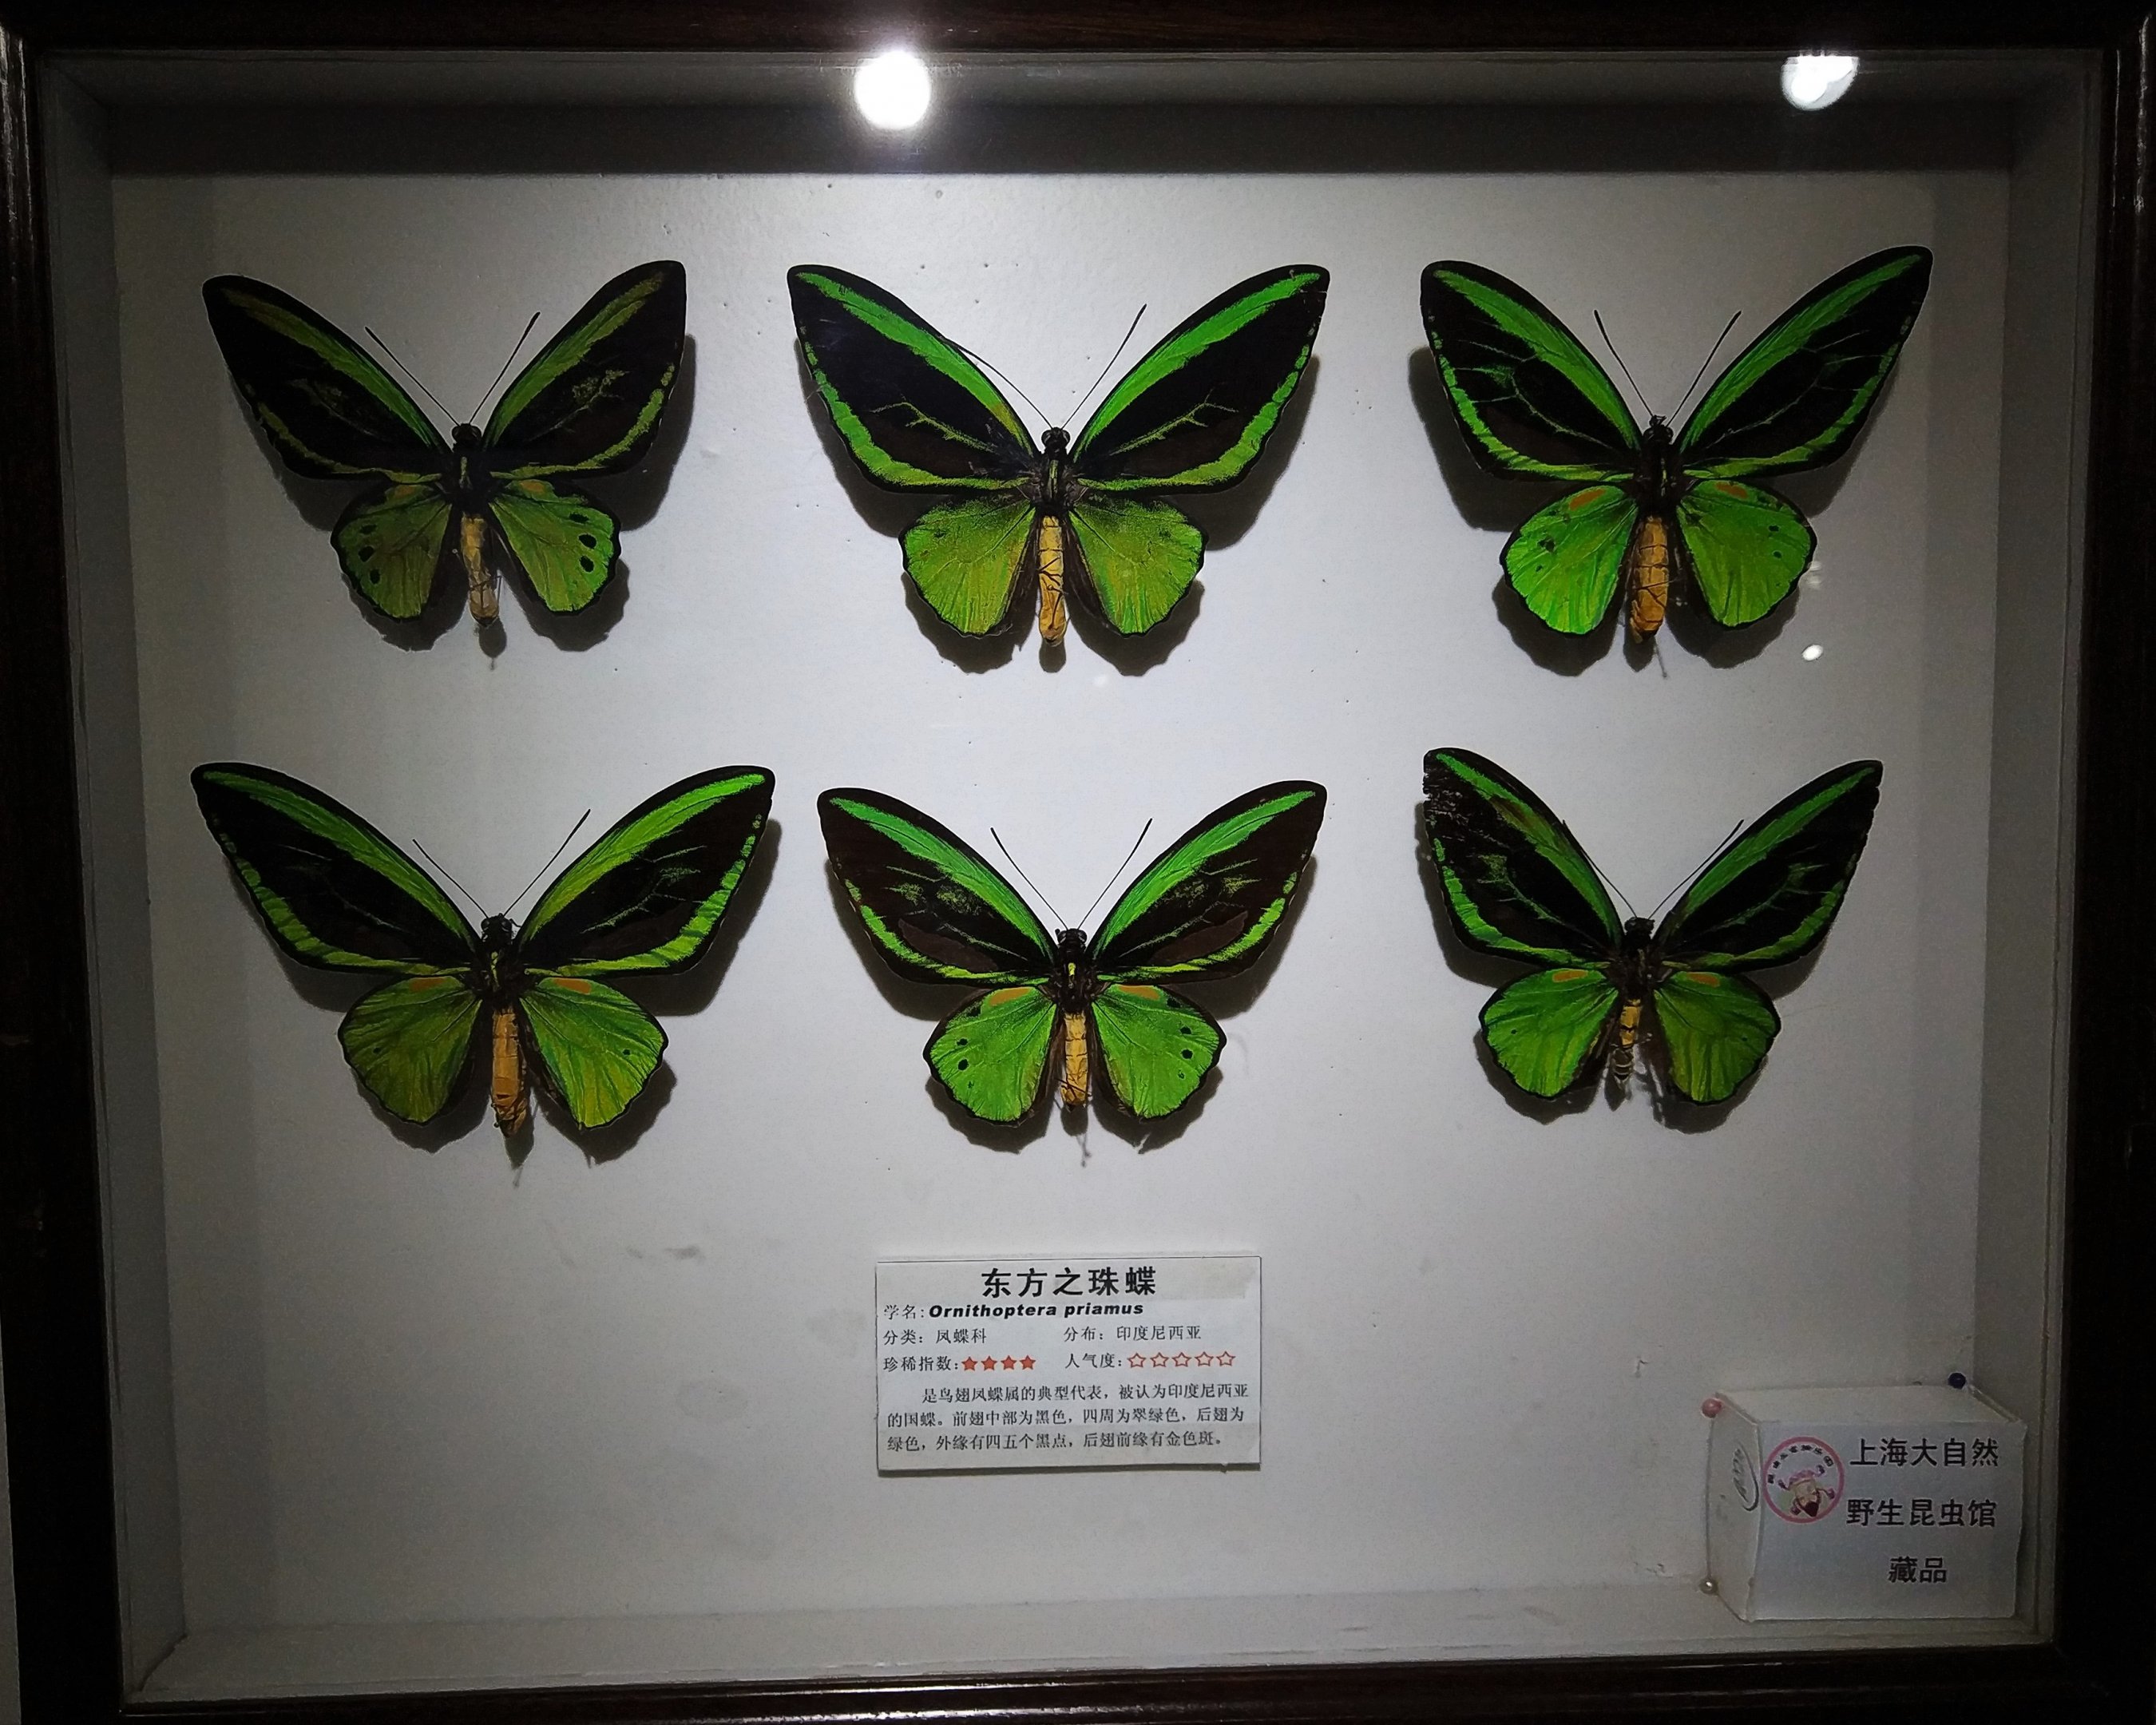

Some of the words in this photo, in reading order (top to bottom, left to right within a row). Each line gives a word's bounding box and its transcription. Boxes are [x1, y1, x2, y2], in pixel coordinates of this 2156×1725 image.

[981, 1267, 1156, 1298] 东方之珠蝶
[1064, 1302, 1143, 1319] priamus
[1849, 1438, 1999, 1467] 上海大自然
[1845, 1498, 1997, 1528] 野生昆虫馆
[1888, 1556, 1948, 1584] 藏品
